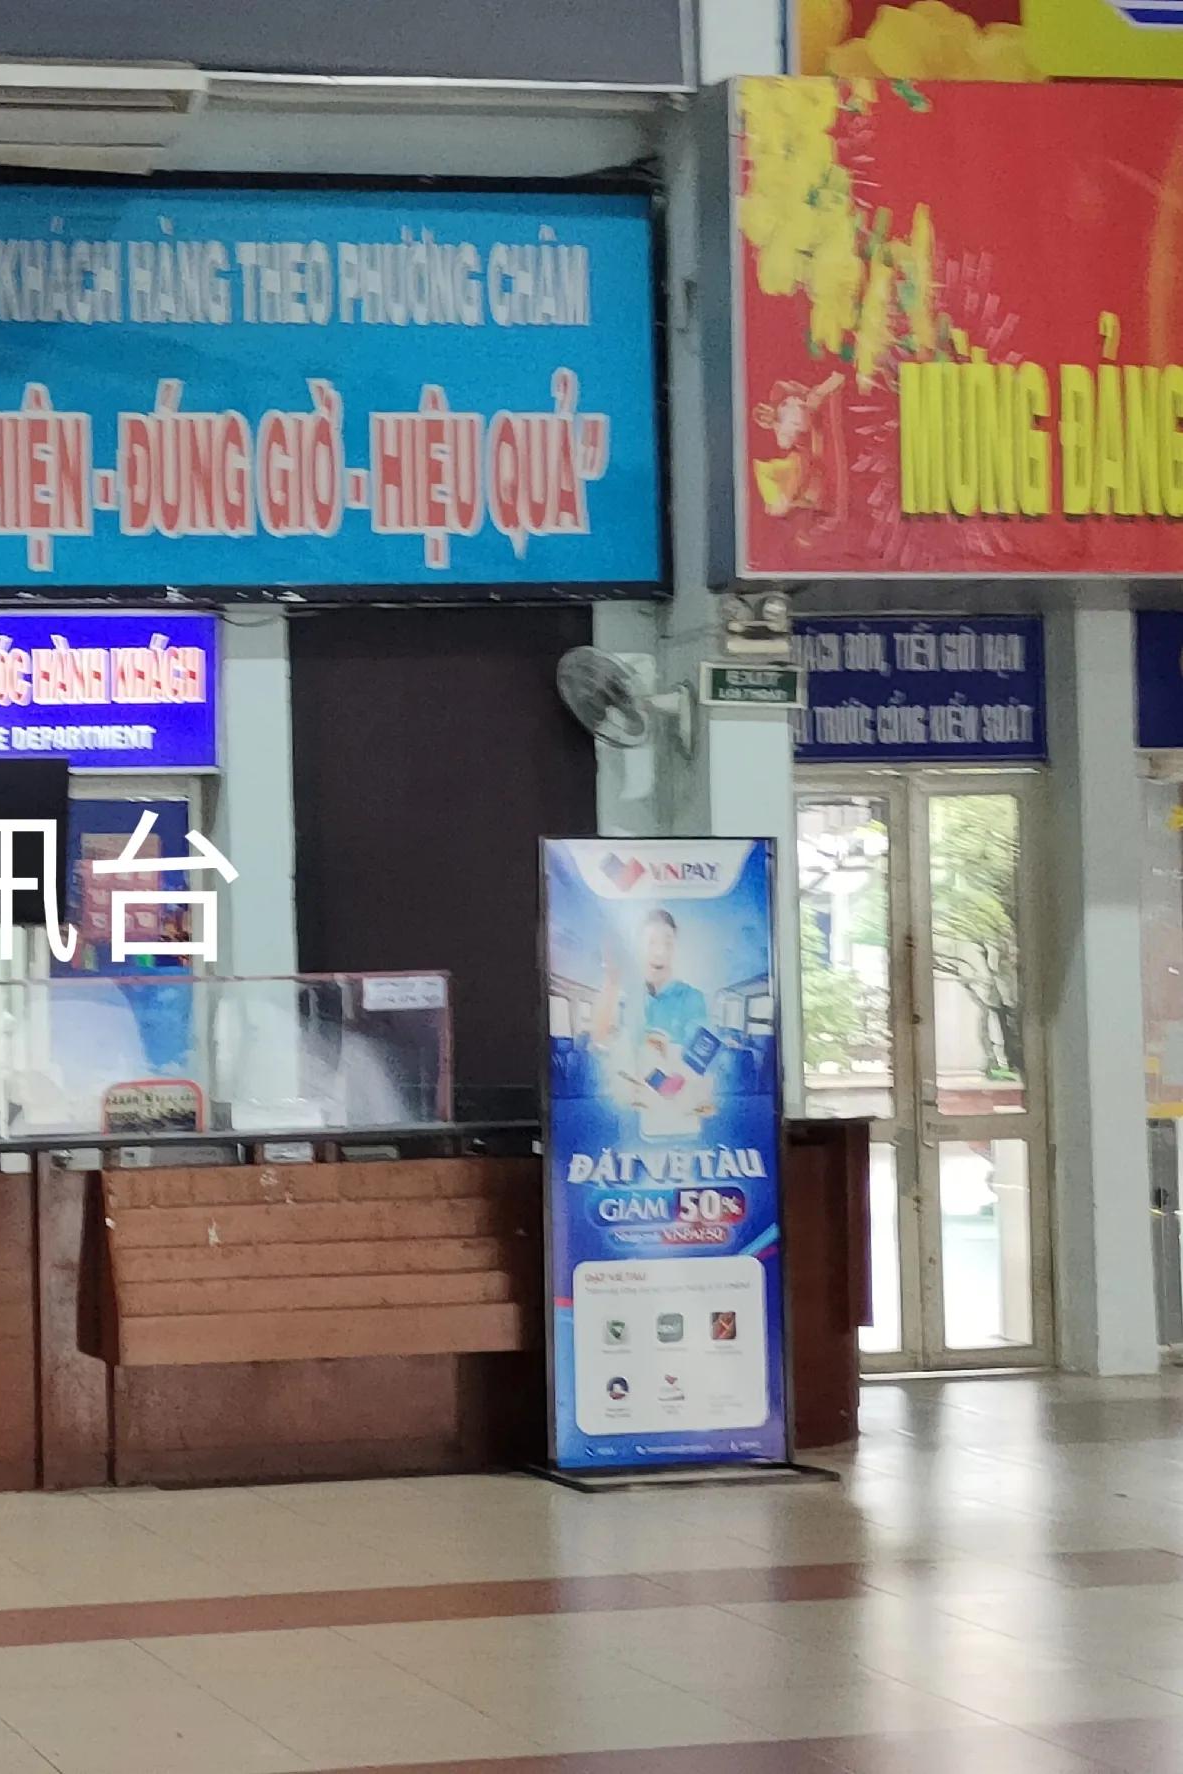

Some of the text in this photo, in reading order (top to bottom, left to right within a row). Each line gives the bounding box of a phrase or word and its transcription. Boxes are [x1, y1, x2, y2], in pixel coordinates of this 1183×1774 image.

[128, 216, 232, 325] HÀNG
[235, 240, 332, 325] THEO
[488, 224, 589, 327] CHÂM
[898, 327, 1051, 517] MỪNG
[117, 378, 257, 537] ĐÚNG
[257, 378, 343, 537] GIỜ
[369, 384, 486, 569] HIỆU
[31, 634, 112, 705] HÀNH
[110, 632, 206, 704] KHÁCH
[11, 725, 157, 751] DEPARTMENT
[567, 1147, 636, 1187] ĐẶT
[694, 1144, 767, 1180] TÀU
